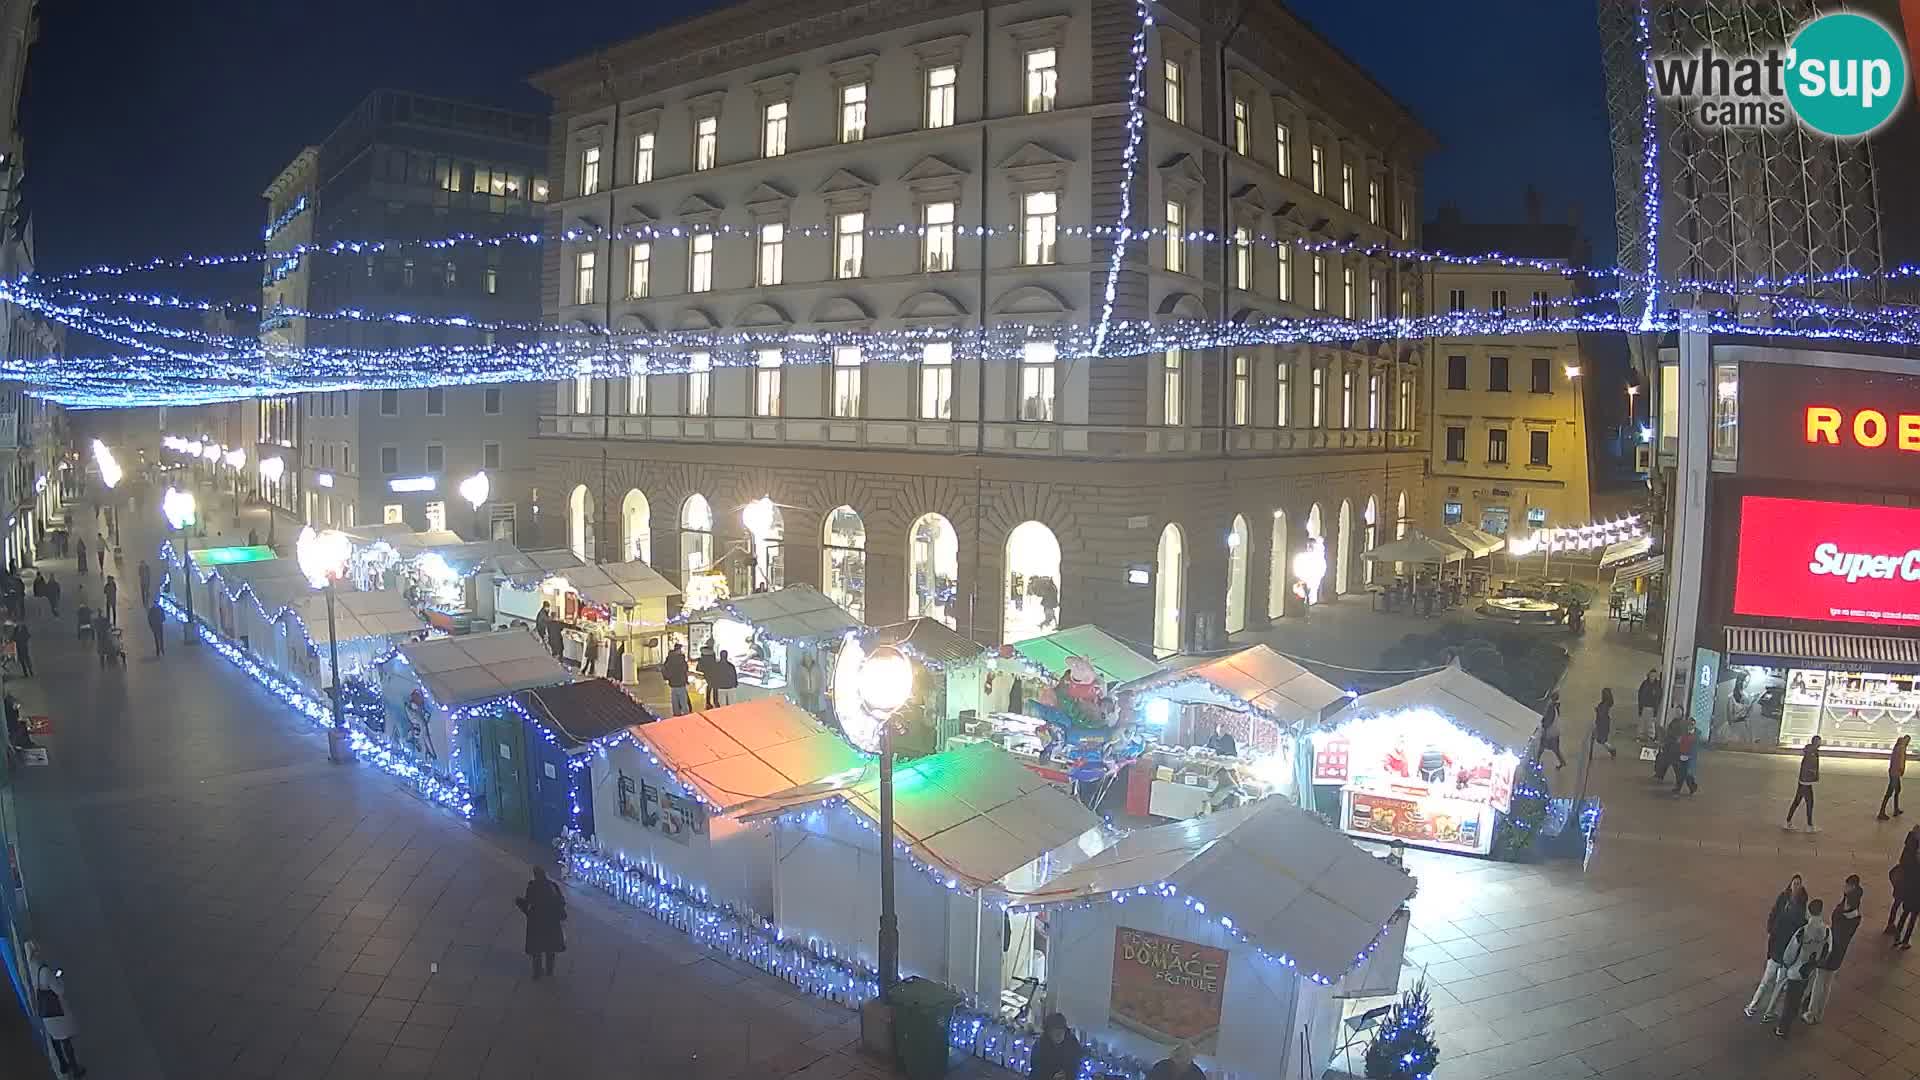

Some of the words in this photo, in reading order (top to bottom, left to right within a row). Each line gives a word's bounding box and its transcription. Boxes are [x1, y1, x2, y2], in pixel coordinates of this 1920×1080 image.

[1809, 542, 1920, 583] SuperC
[1122, 944, 1220, 980] DOMAĆE
[1155, 969, 1218, 993] FRITULE
